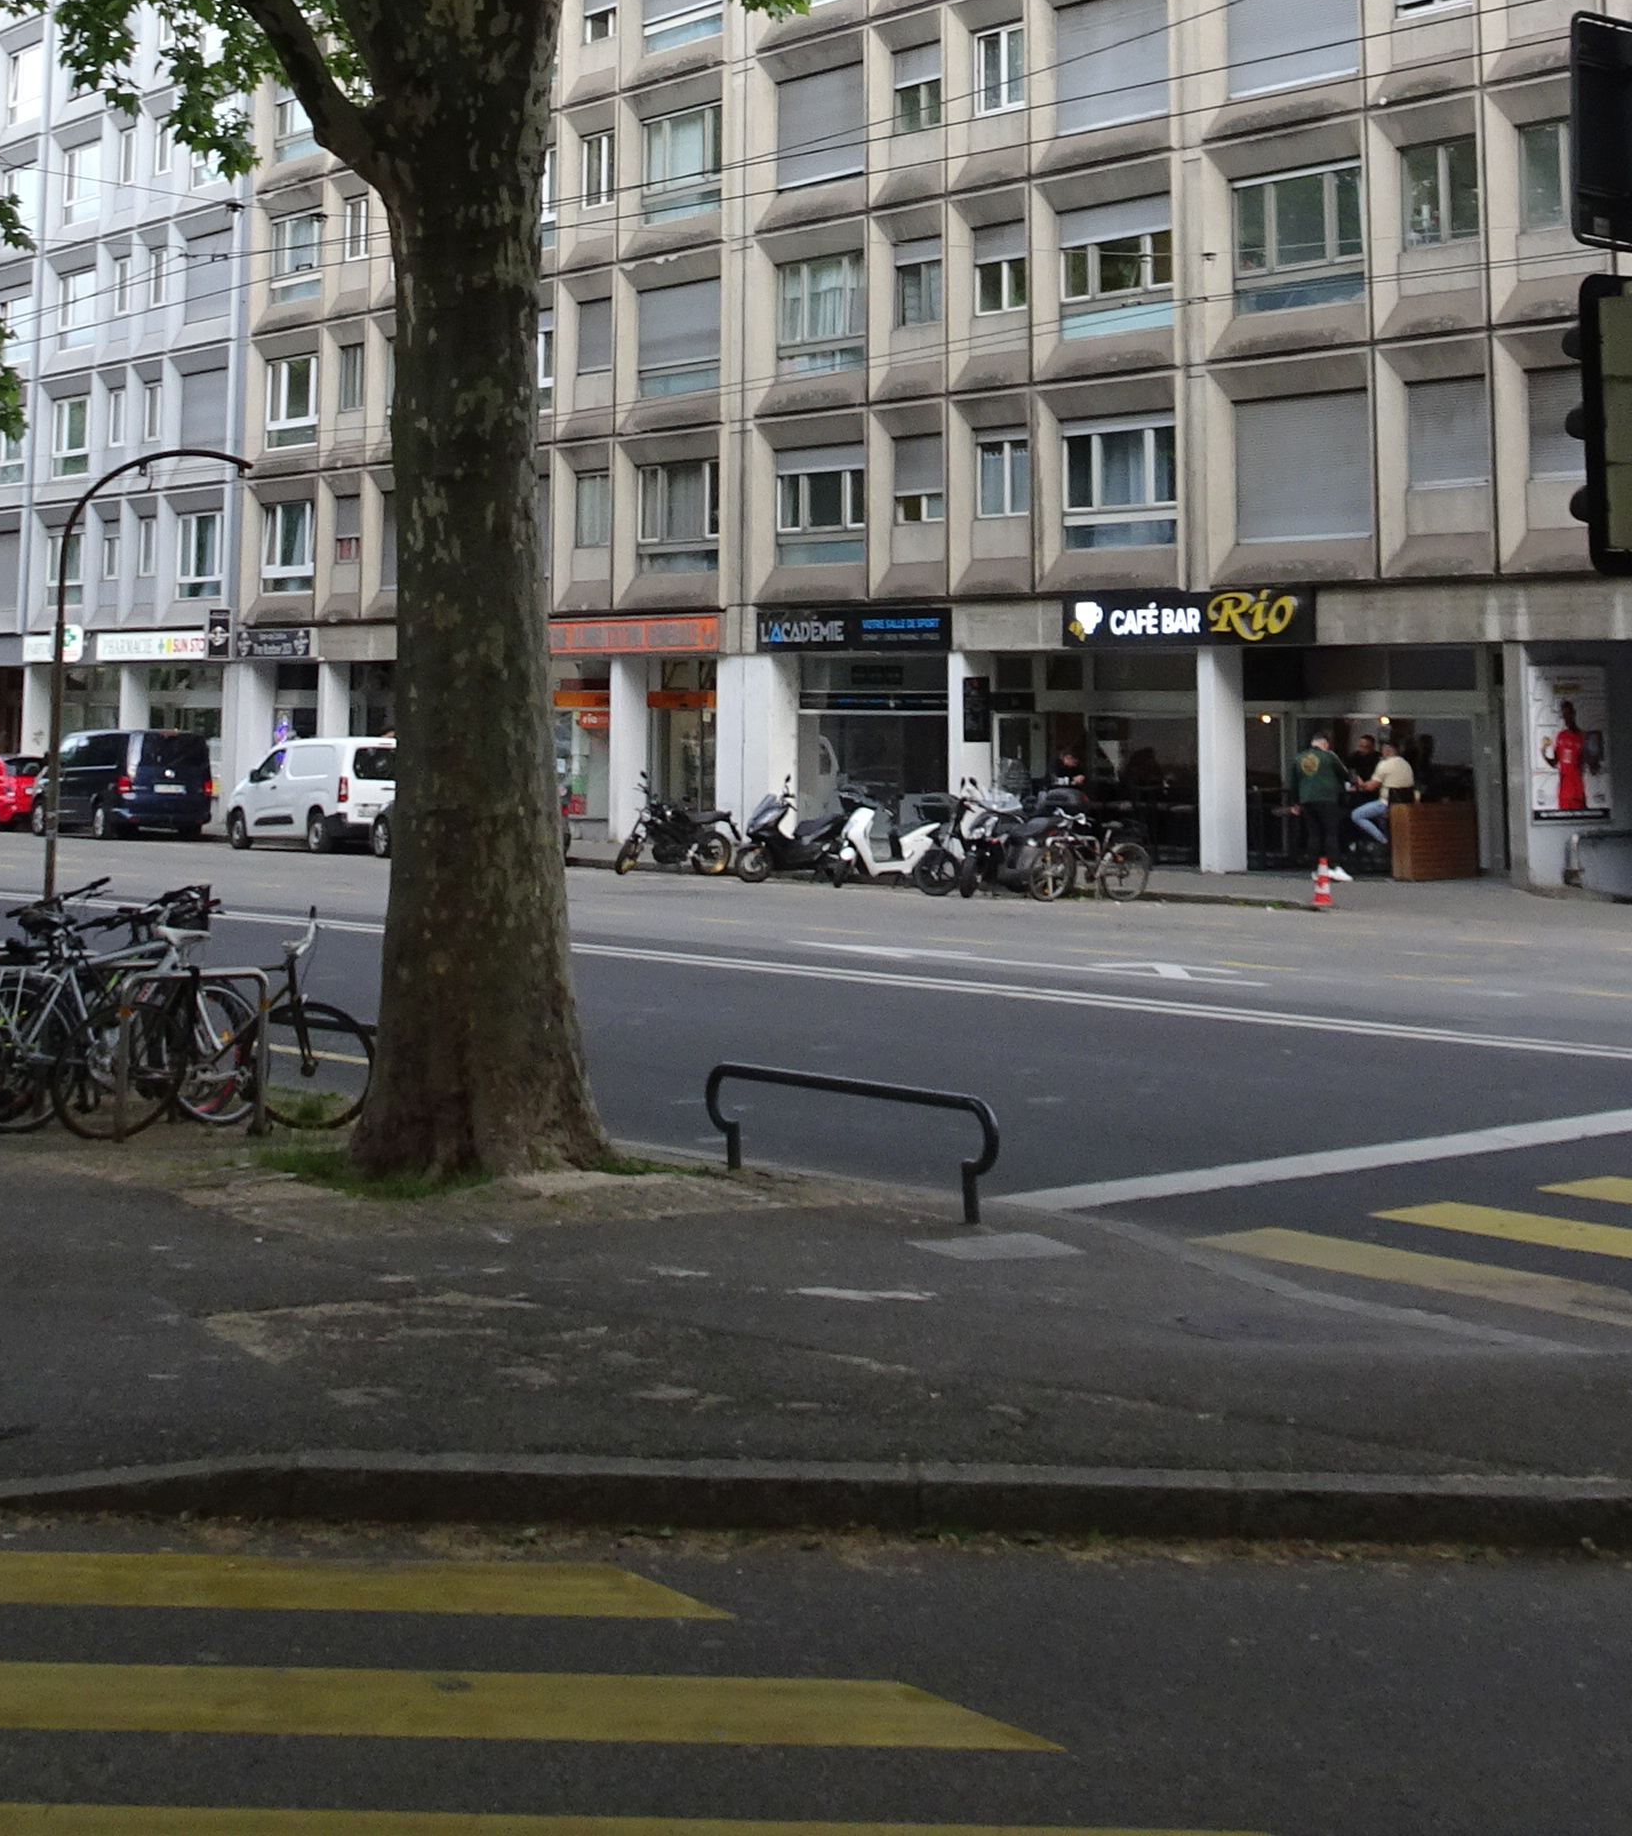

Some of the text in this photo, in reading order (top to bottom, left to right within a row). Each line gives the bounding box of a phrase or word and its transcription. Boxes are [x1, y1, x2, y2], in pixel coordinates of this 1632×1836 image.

[1110, 589, 1298, 641] CAFÉ BAR Rio
[172, 637, 189, 653] SUN
